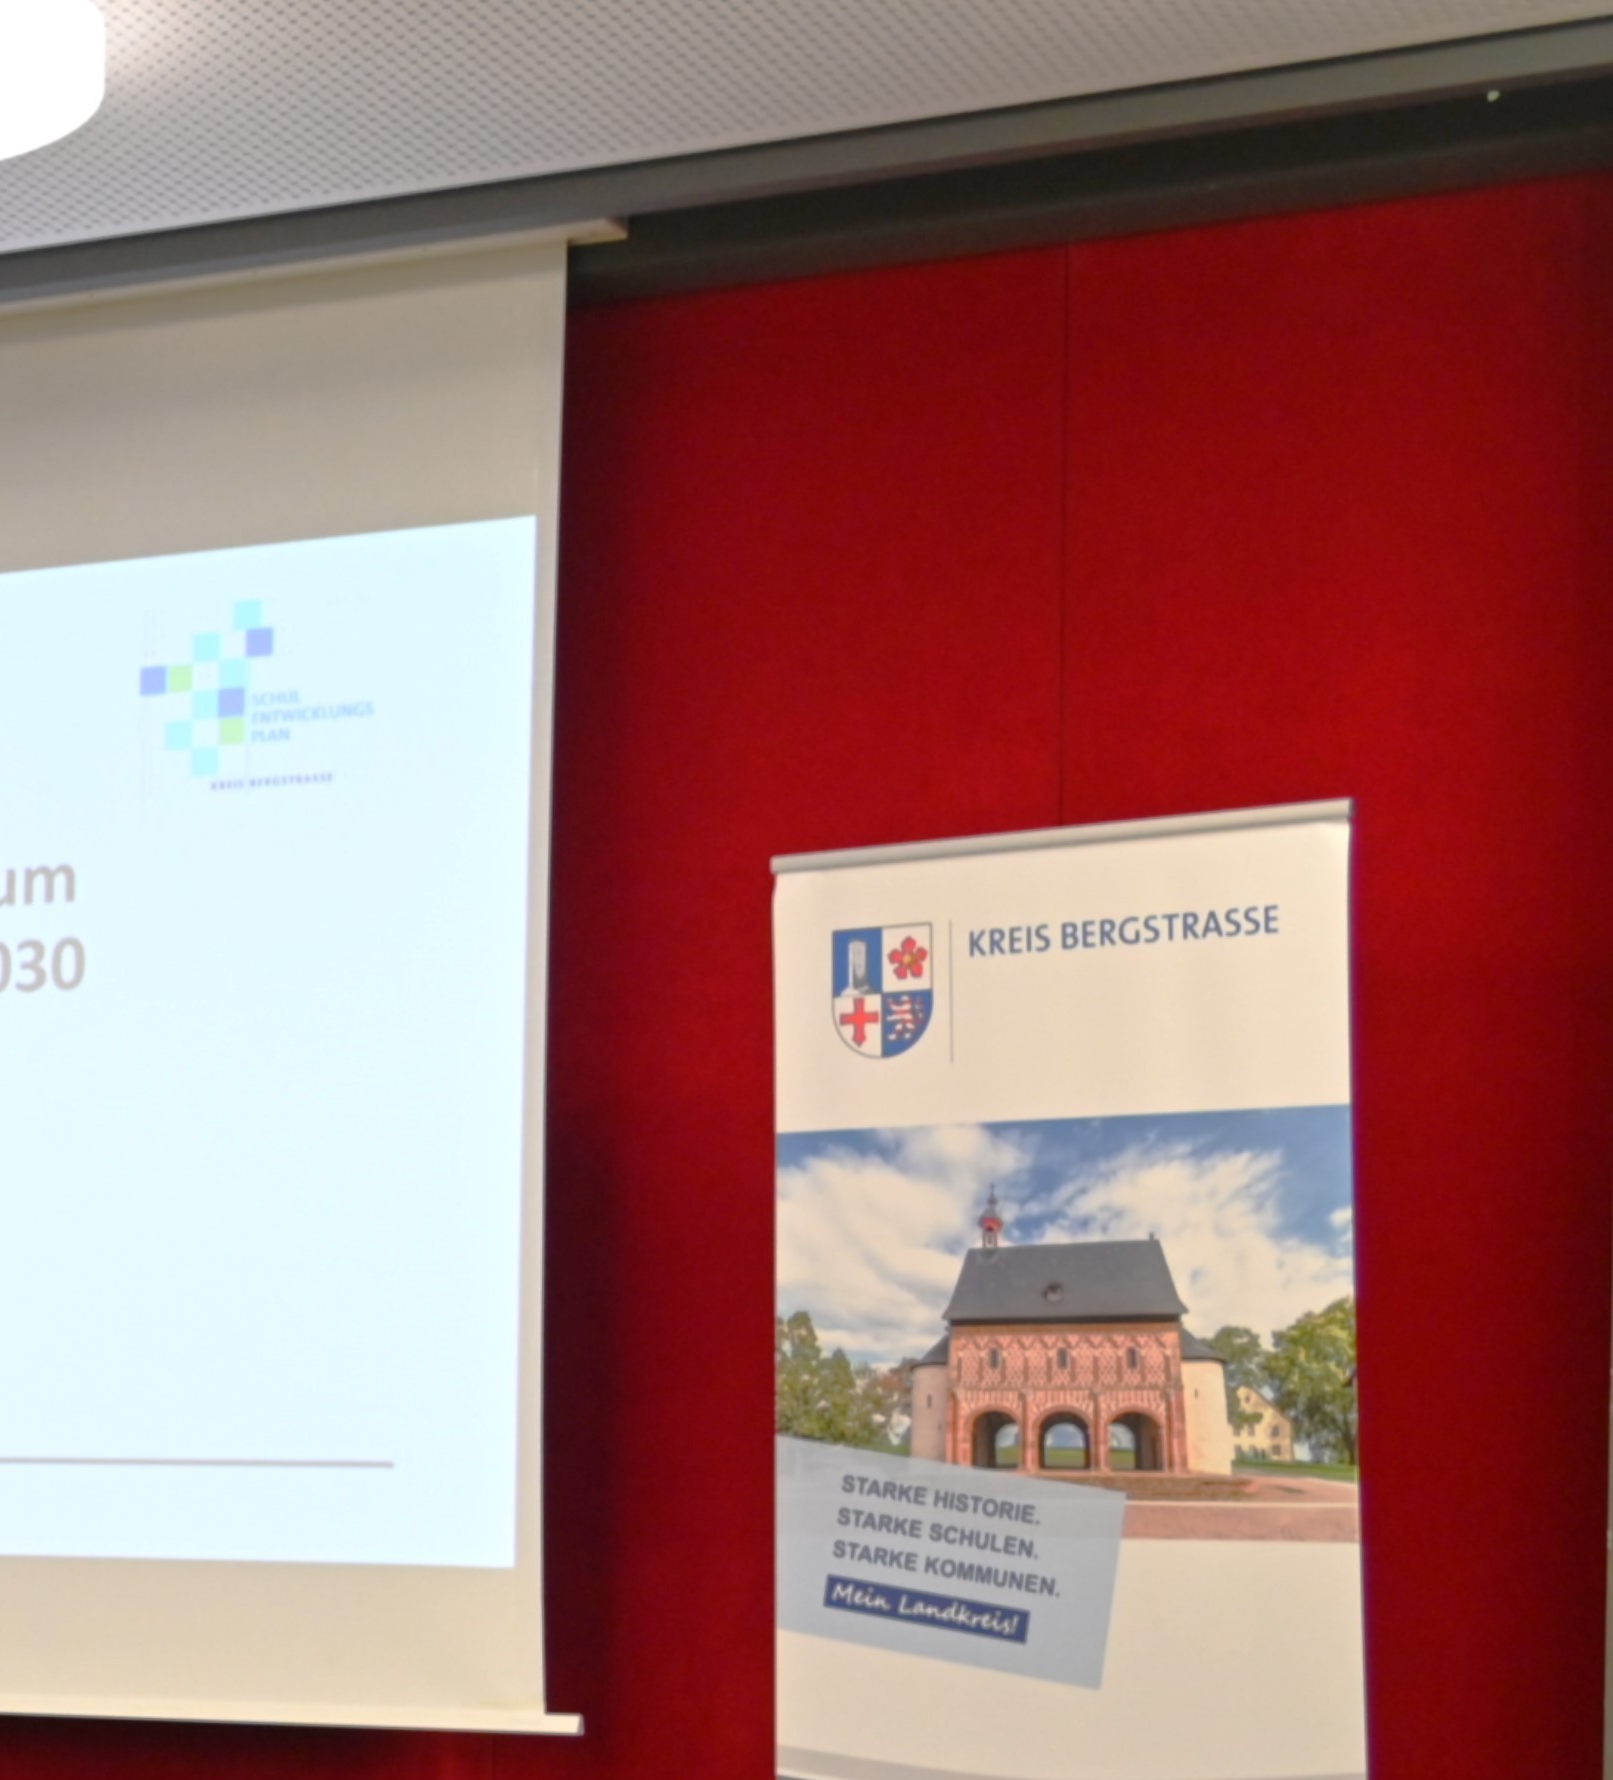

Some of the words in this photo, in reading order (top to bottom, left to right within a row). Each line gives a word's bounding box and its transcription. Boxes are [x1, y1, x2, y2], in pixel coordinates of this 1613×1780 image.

[251, 700, 374, 725] ENTWICKLUNGS
[251, 727, 291, 743] PLAN
[969, 924, 1051, 958] KREIS
[1060, 904, 1279, 952] BERGSTRASSE
[842, 1474, 927, 1506] STARKE
[933, 1489, 1041, 1525] HISTORIE.
[837, 1507, 922, 1539] STARKE
[929, 1522, 1039, 1559] SCHULEN.
[832, 1540, 917, 1572] STARKE
[924, 1556, 1061, 1598] KOMMUNEN.
[832, 1583, 891, 1611] Mein
[898, 1594, 1019, 1635] Landkreis!
